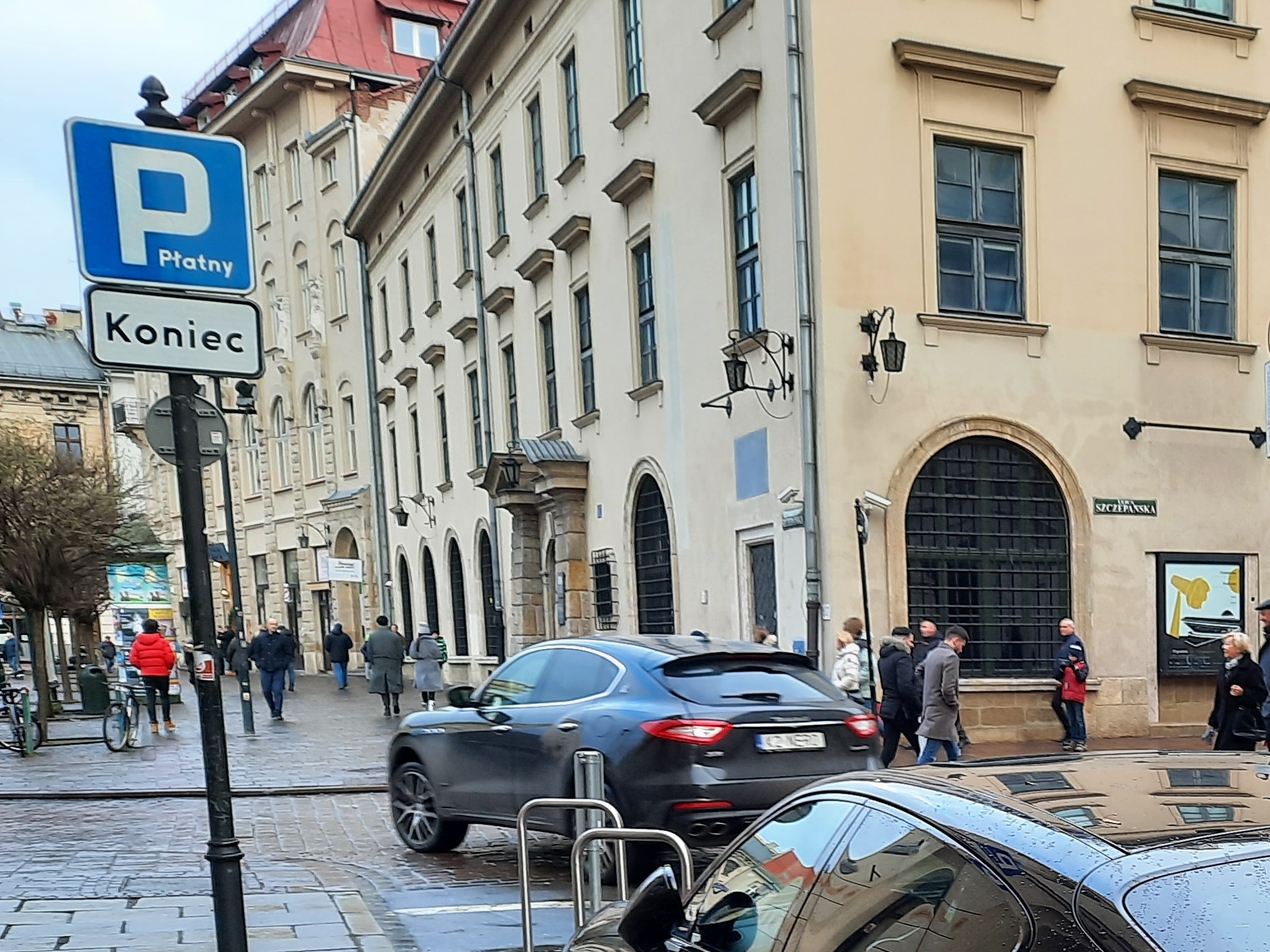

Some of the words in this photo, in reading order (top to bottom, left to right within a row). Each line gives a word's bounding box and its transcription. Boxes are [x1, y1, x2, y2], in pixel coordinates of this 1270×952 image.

[110, 142, 212, 265] P
[158, 248, 233, 278] Płatny
[105, 312, 244, 353] Koniec
